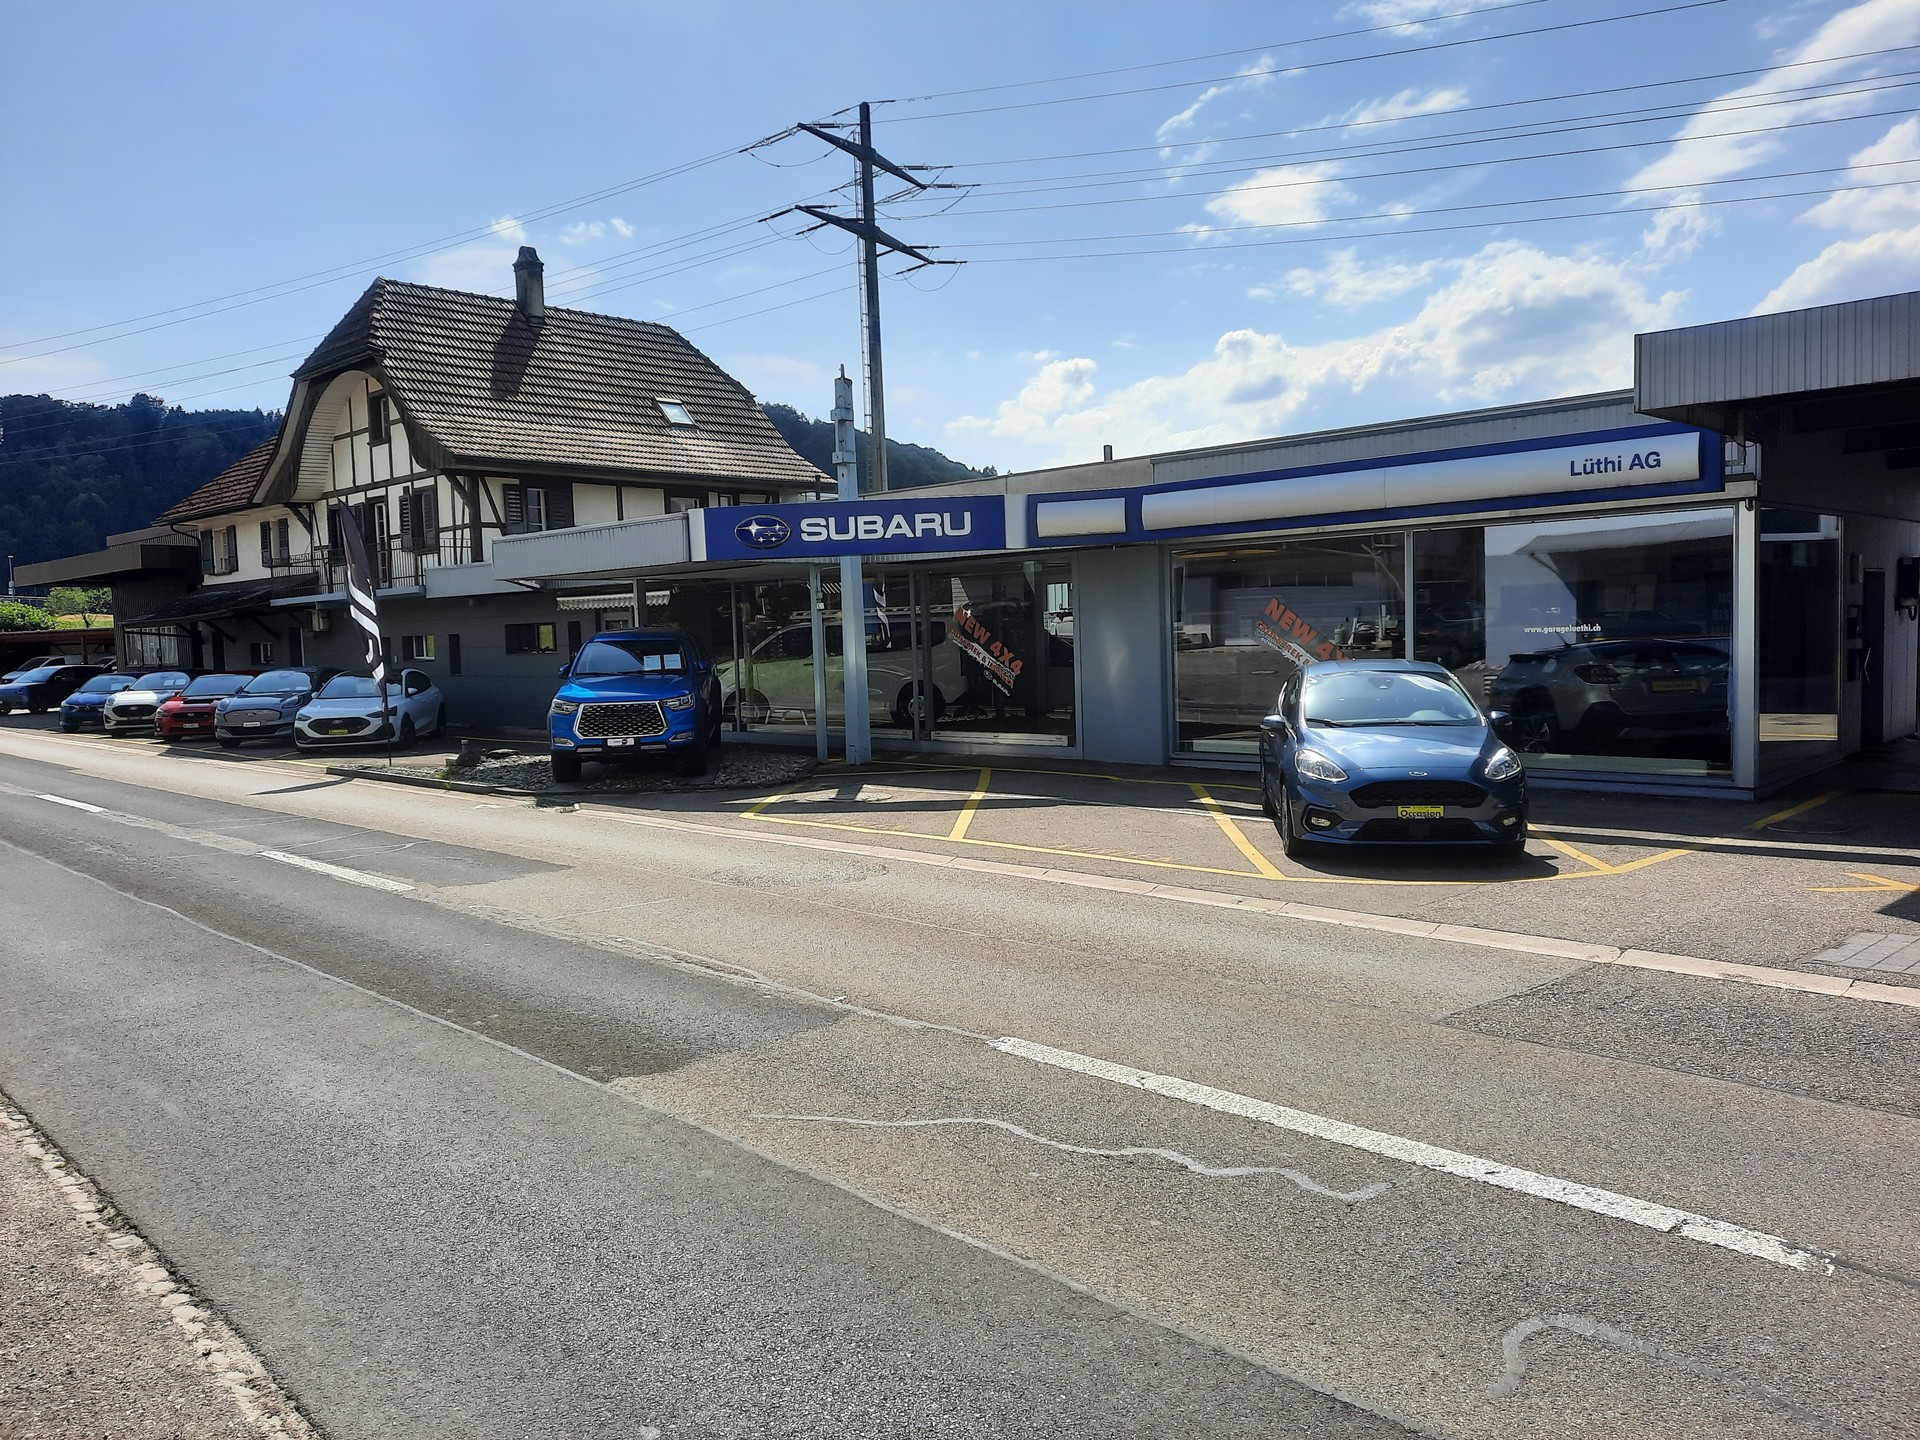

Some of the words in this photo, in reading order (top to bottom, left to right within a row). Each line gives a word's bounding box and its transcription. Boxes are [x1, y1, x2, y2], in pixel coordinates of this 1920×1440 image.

[1570, 455, 1622, 477] Lüthi
[1628, 451, 1661, 471] AG
[800, 511, 972, 542] SUBARU
[1264, 598, 1318, 646] NEW
[1523, 623, 1602, 634] www.garageluethi.ch
[954, 607, 991, 645] NEW
[989, 640, 1024, 676] 4X4
[1400, 809, 1441, 818] Occasion
